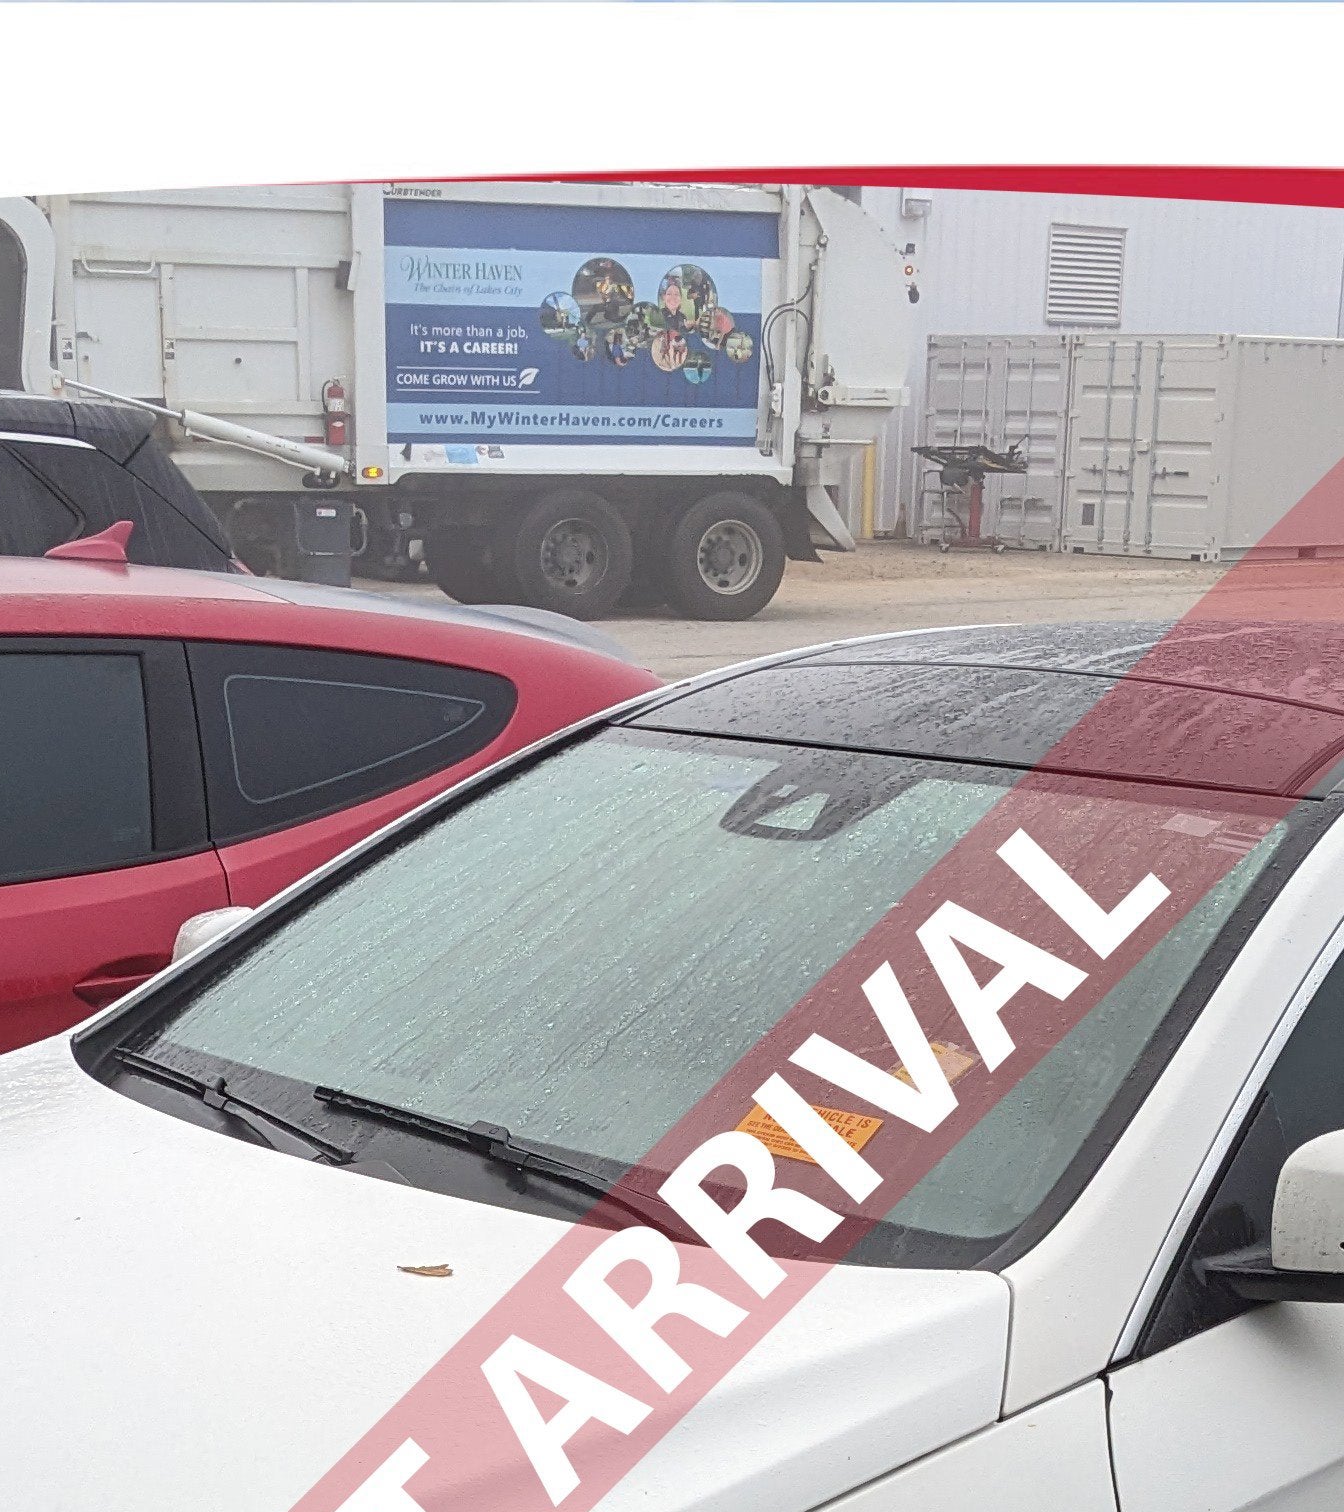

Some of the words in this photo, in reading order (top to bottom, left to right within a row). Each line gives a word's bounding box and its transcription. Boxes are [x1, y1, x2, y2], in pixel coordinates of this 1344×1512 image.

[400, 255, 472, 281] WINTER
[474, 262, 523, 281] HAVEN
[414, 283, 431, 292] The
[433, 283, 461, 293] Chain
[504, 285, 523, 296] City
[410, 323, 428, 336] It's
[431, 327, 463, 338] more
[466, 324, 493, 338] than
[496, 328, 504, 339] a
[506, 325, 529, 341] job,
[420, 341, 446, 353] IT'S
[449, 341, 460, 353] A
[463, 342, 518, 355] CAREER!
[396, 373, 430, 385] COME
[432, 374, 468, 386] GROW
[470, 374, 500, 387] WITH
[502, 375, 517, 387] US
[419, 411, 724, 429] www.MyWinterHaven.com/Careers
[856, 1117, 872, 1129] IS
